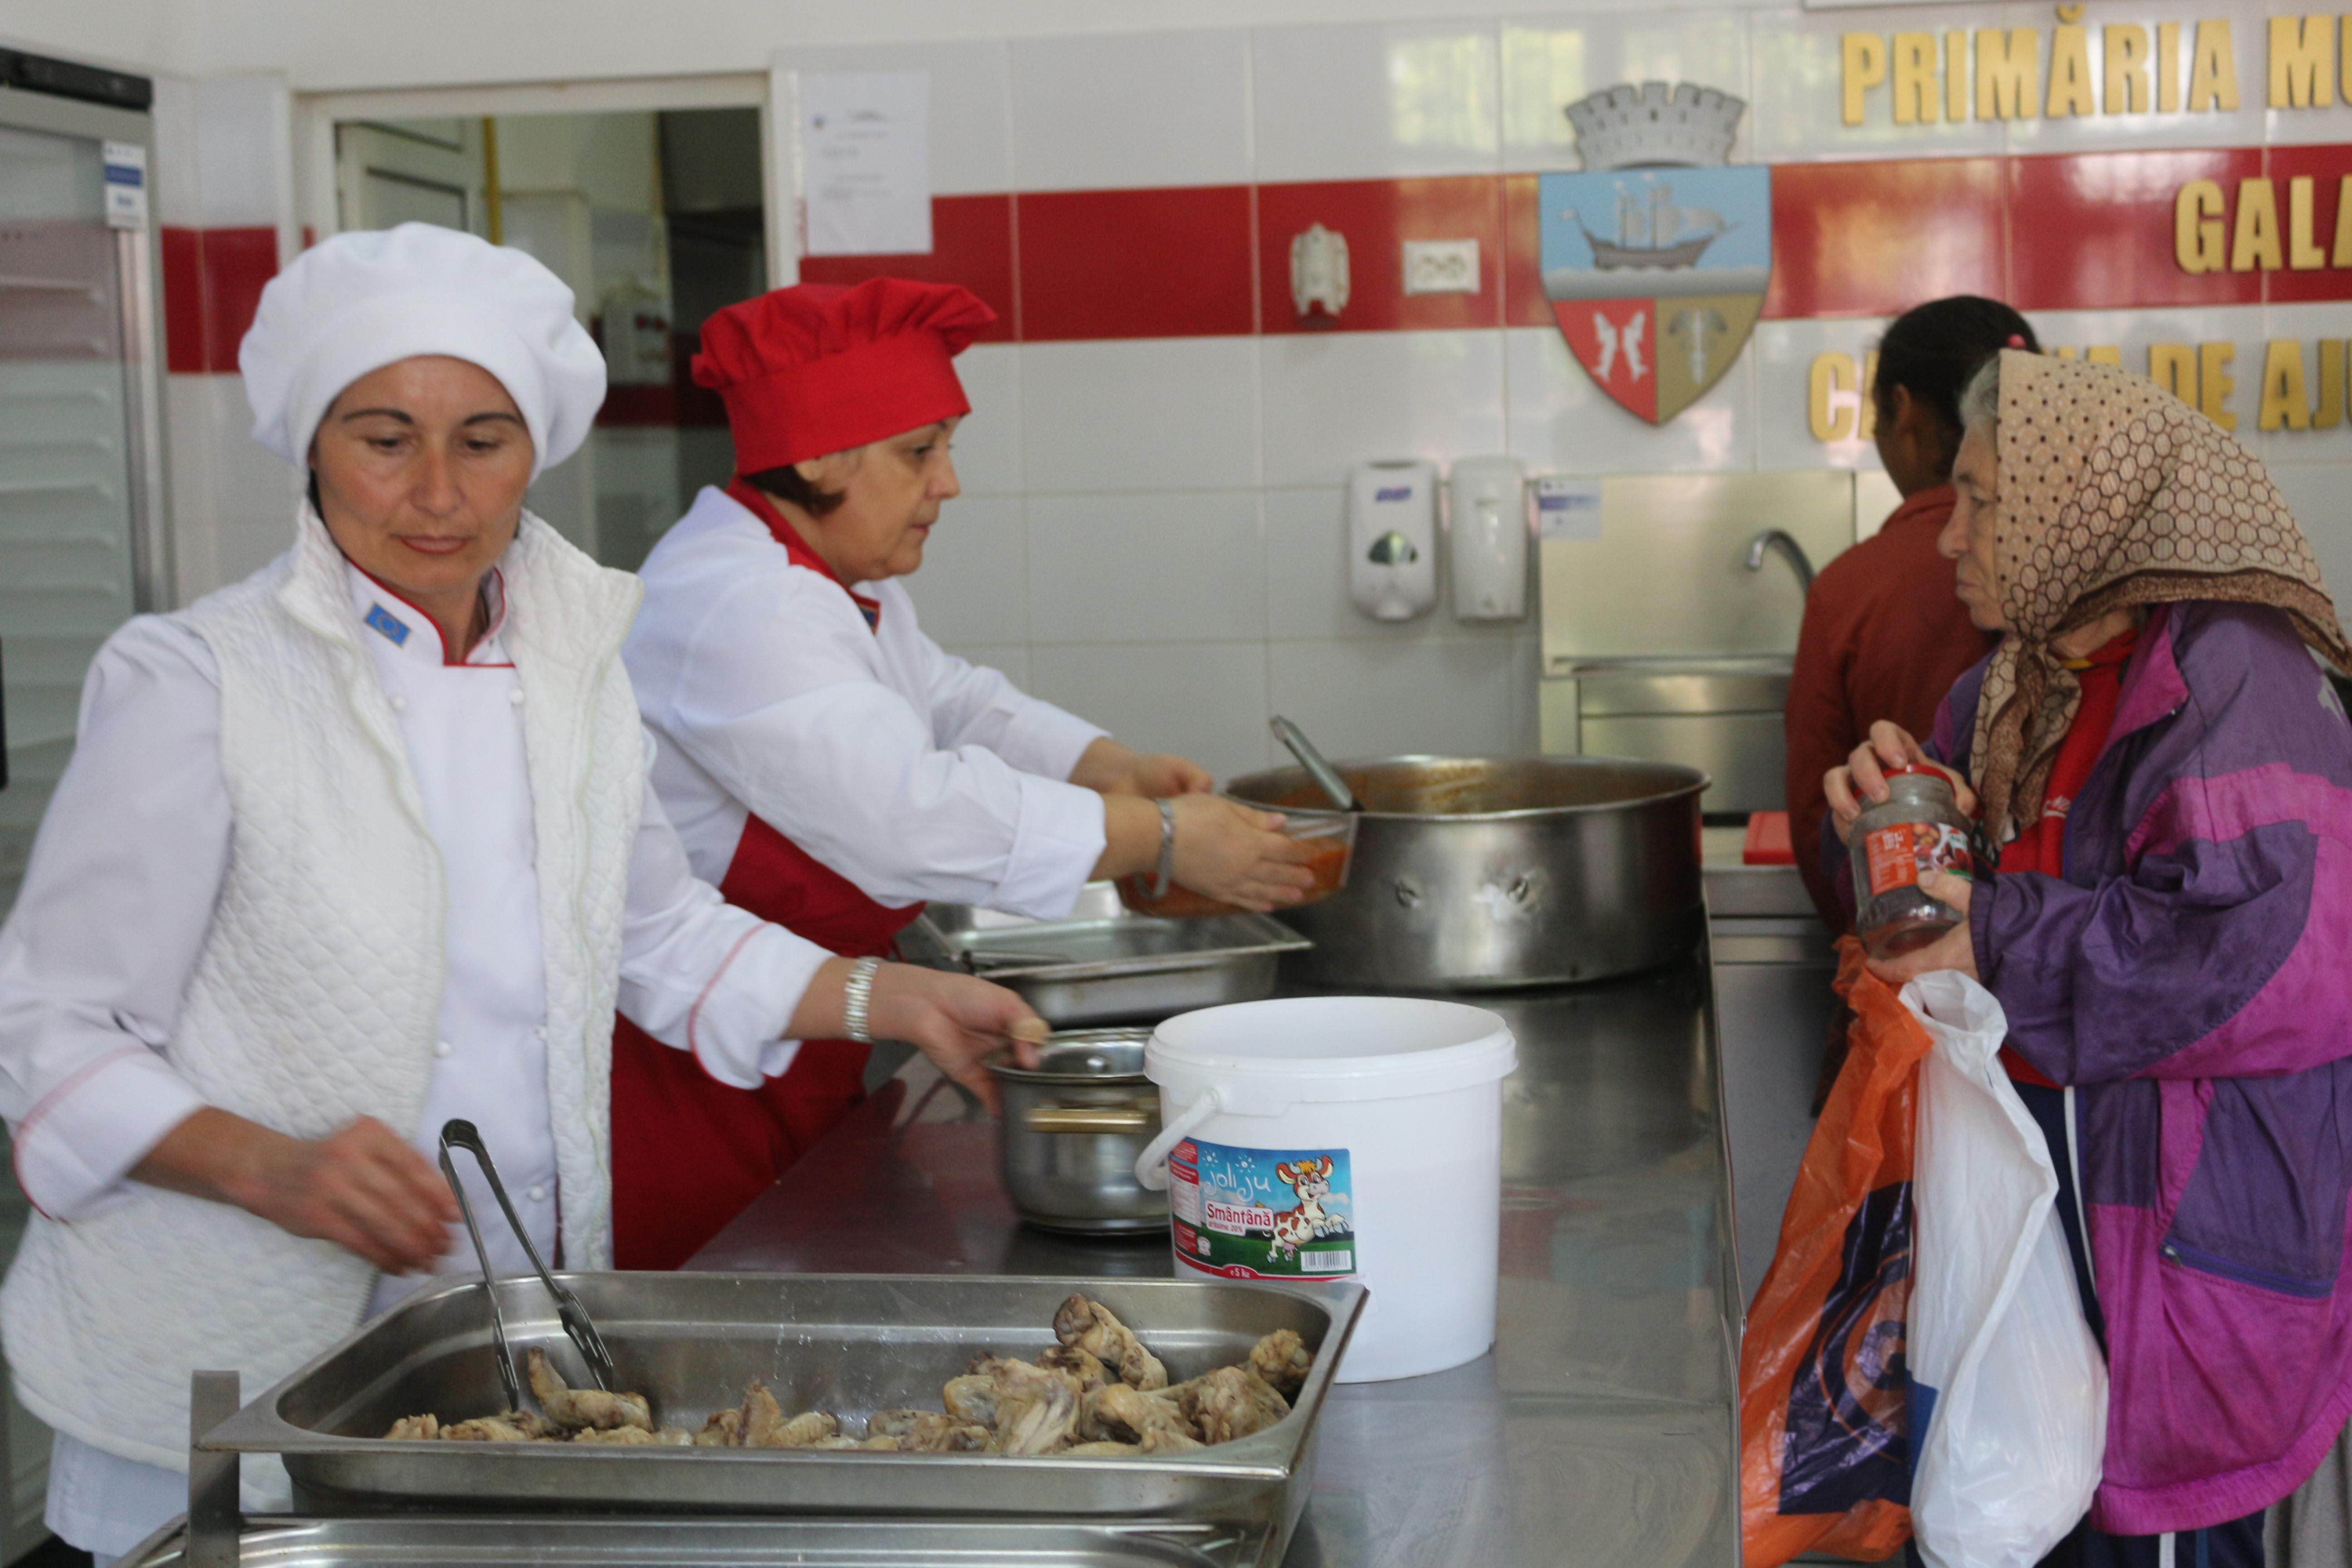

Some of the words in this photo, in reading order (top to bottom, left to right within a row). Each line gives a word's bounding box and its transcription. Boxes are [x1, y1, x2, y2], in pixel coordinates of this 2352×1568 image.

[1841, 2, 2239, 126] PRIMĂRIA
[2268, 14, 2352, 109] M
[2258, 338, 2352, 431] AJ
